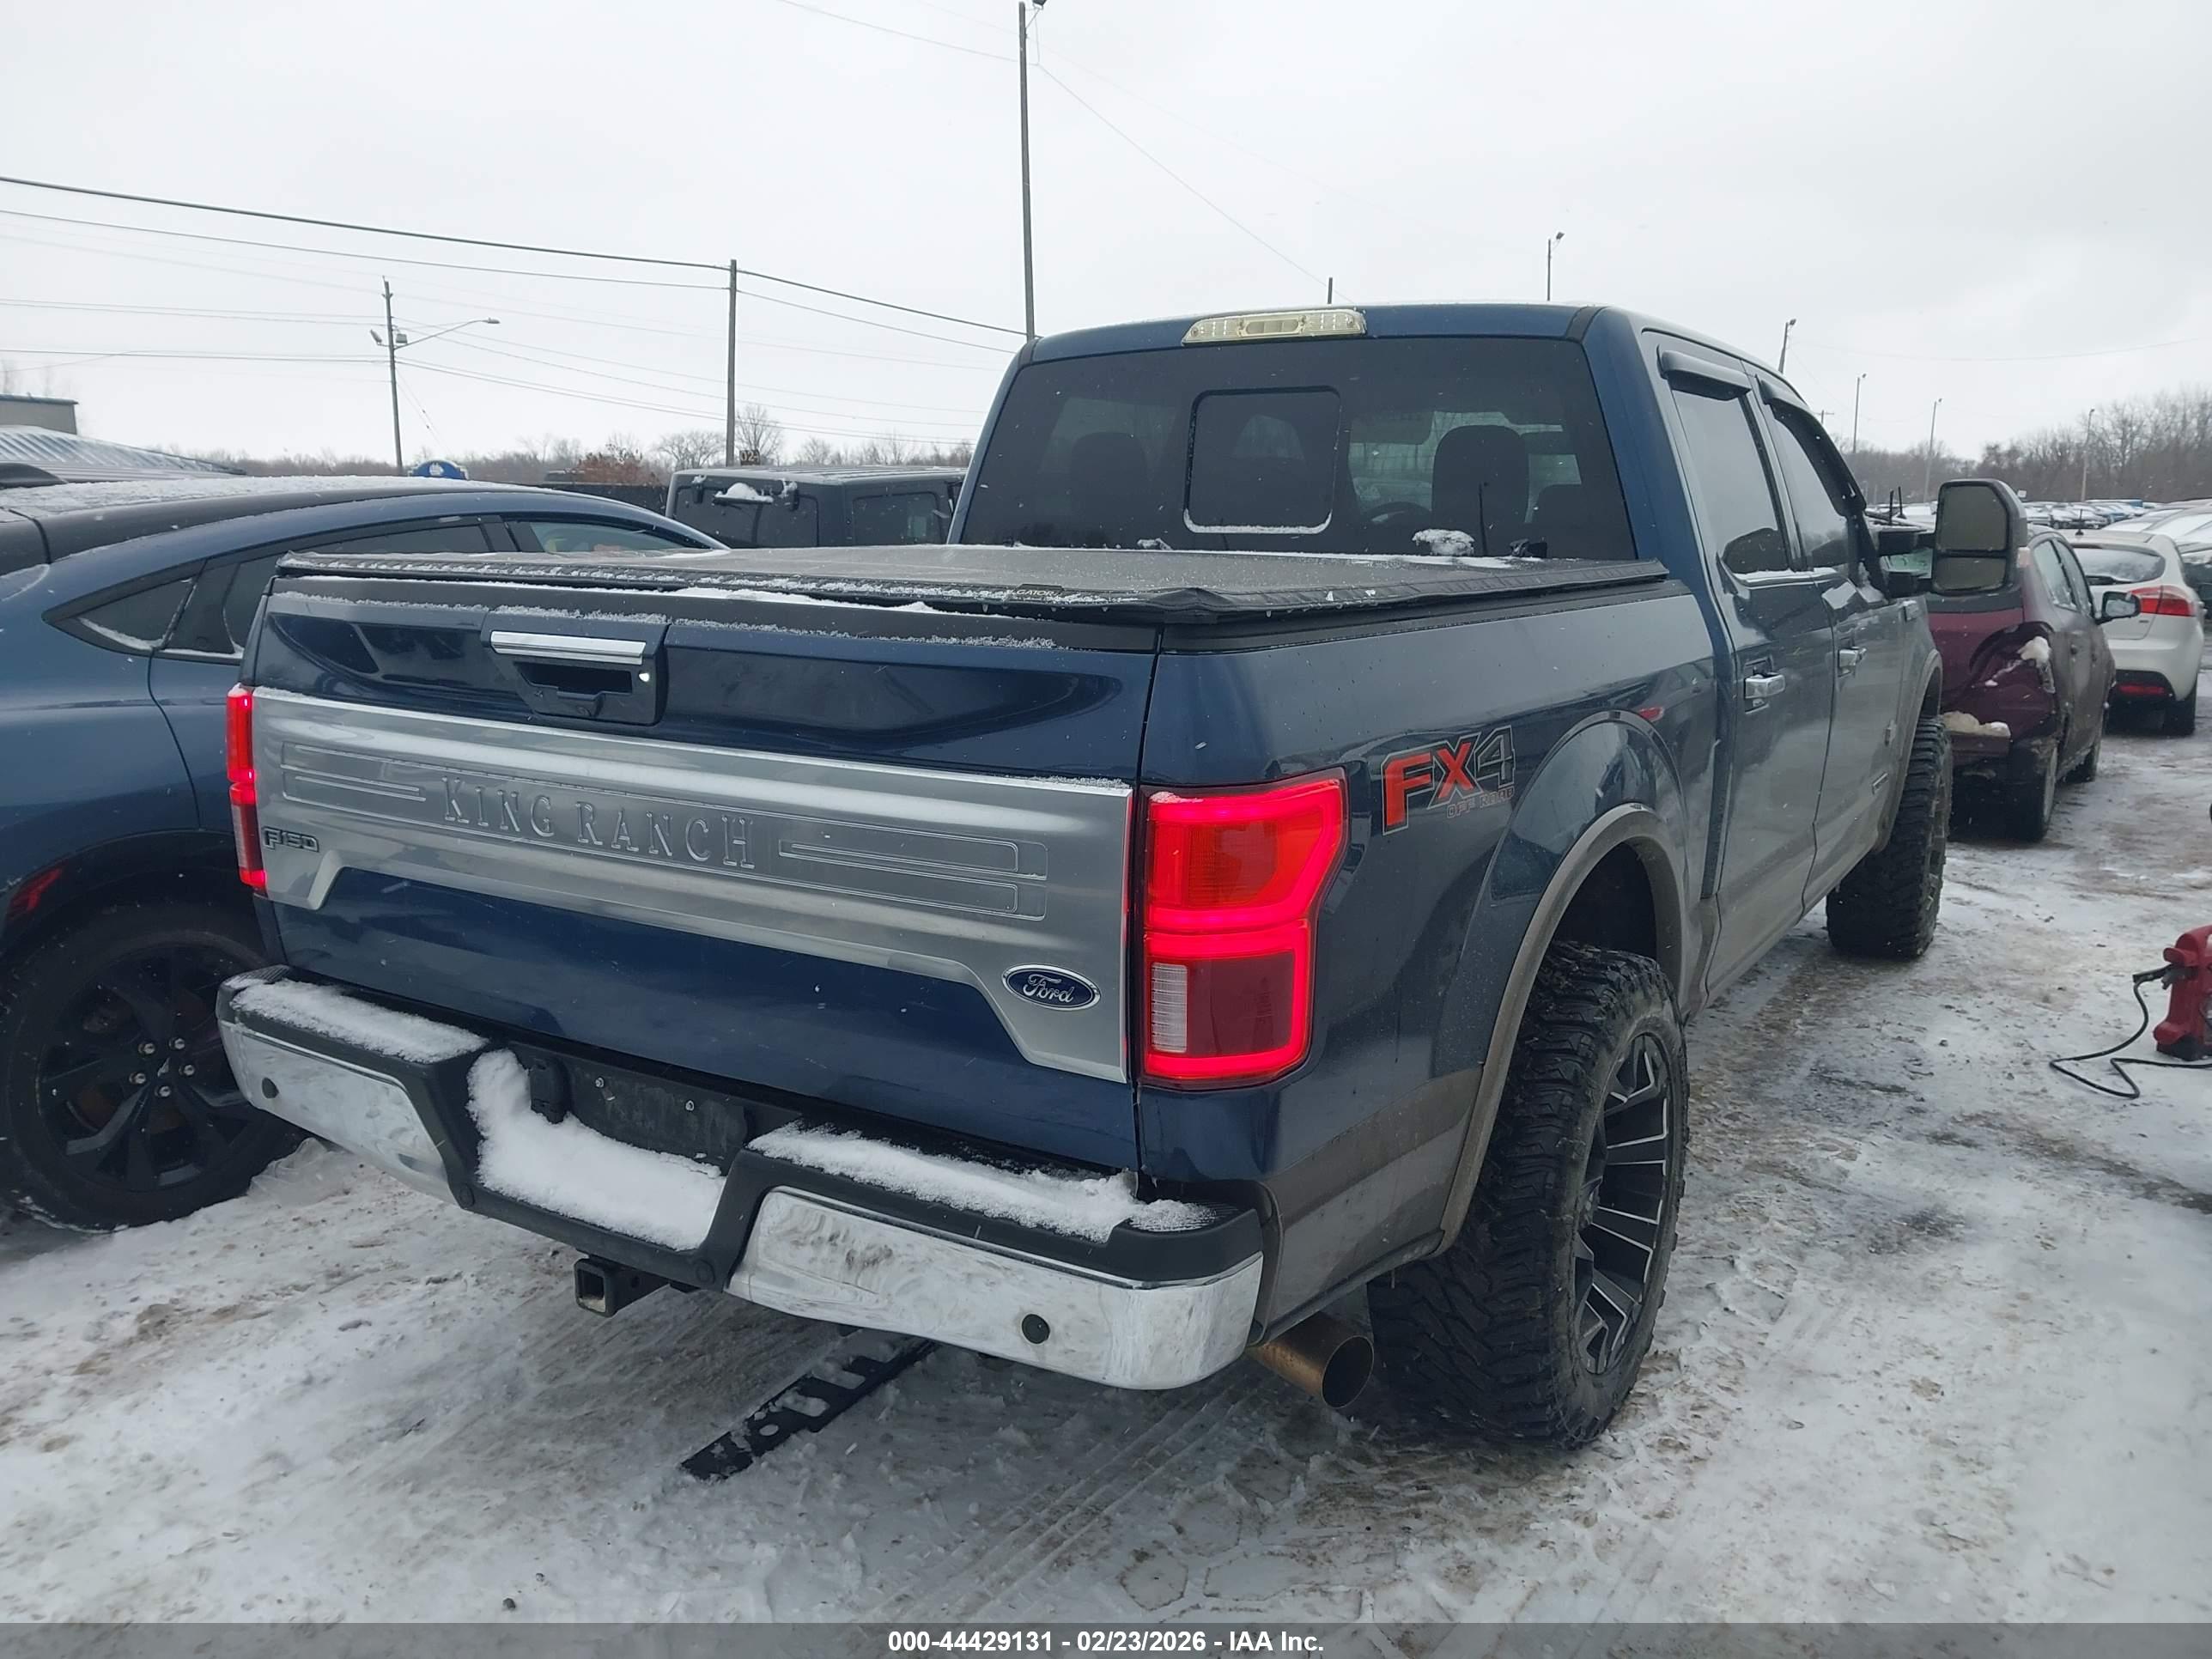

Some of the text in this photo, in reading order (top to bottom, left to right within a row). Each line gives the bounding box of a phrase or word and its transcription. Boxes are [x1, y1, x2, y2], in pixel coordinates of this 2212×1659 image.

[441, 775, 755, 869] KING RANCH
[1380, 724, 1516, 836] FX4
[1022, 973, 1076, 1004] Ford
